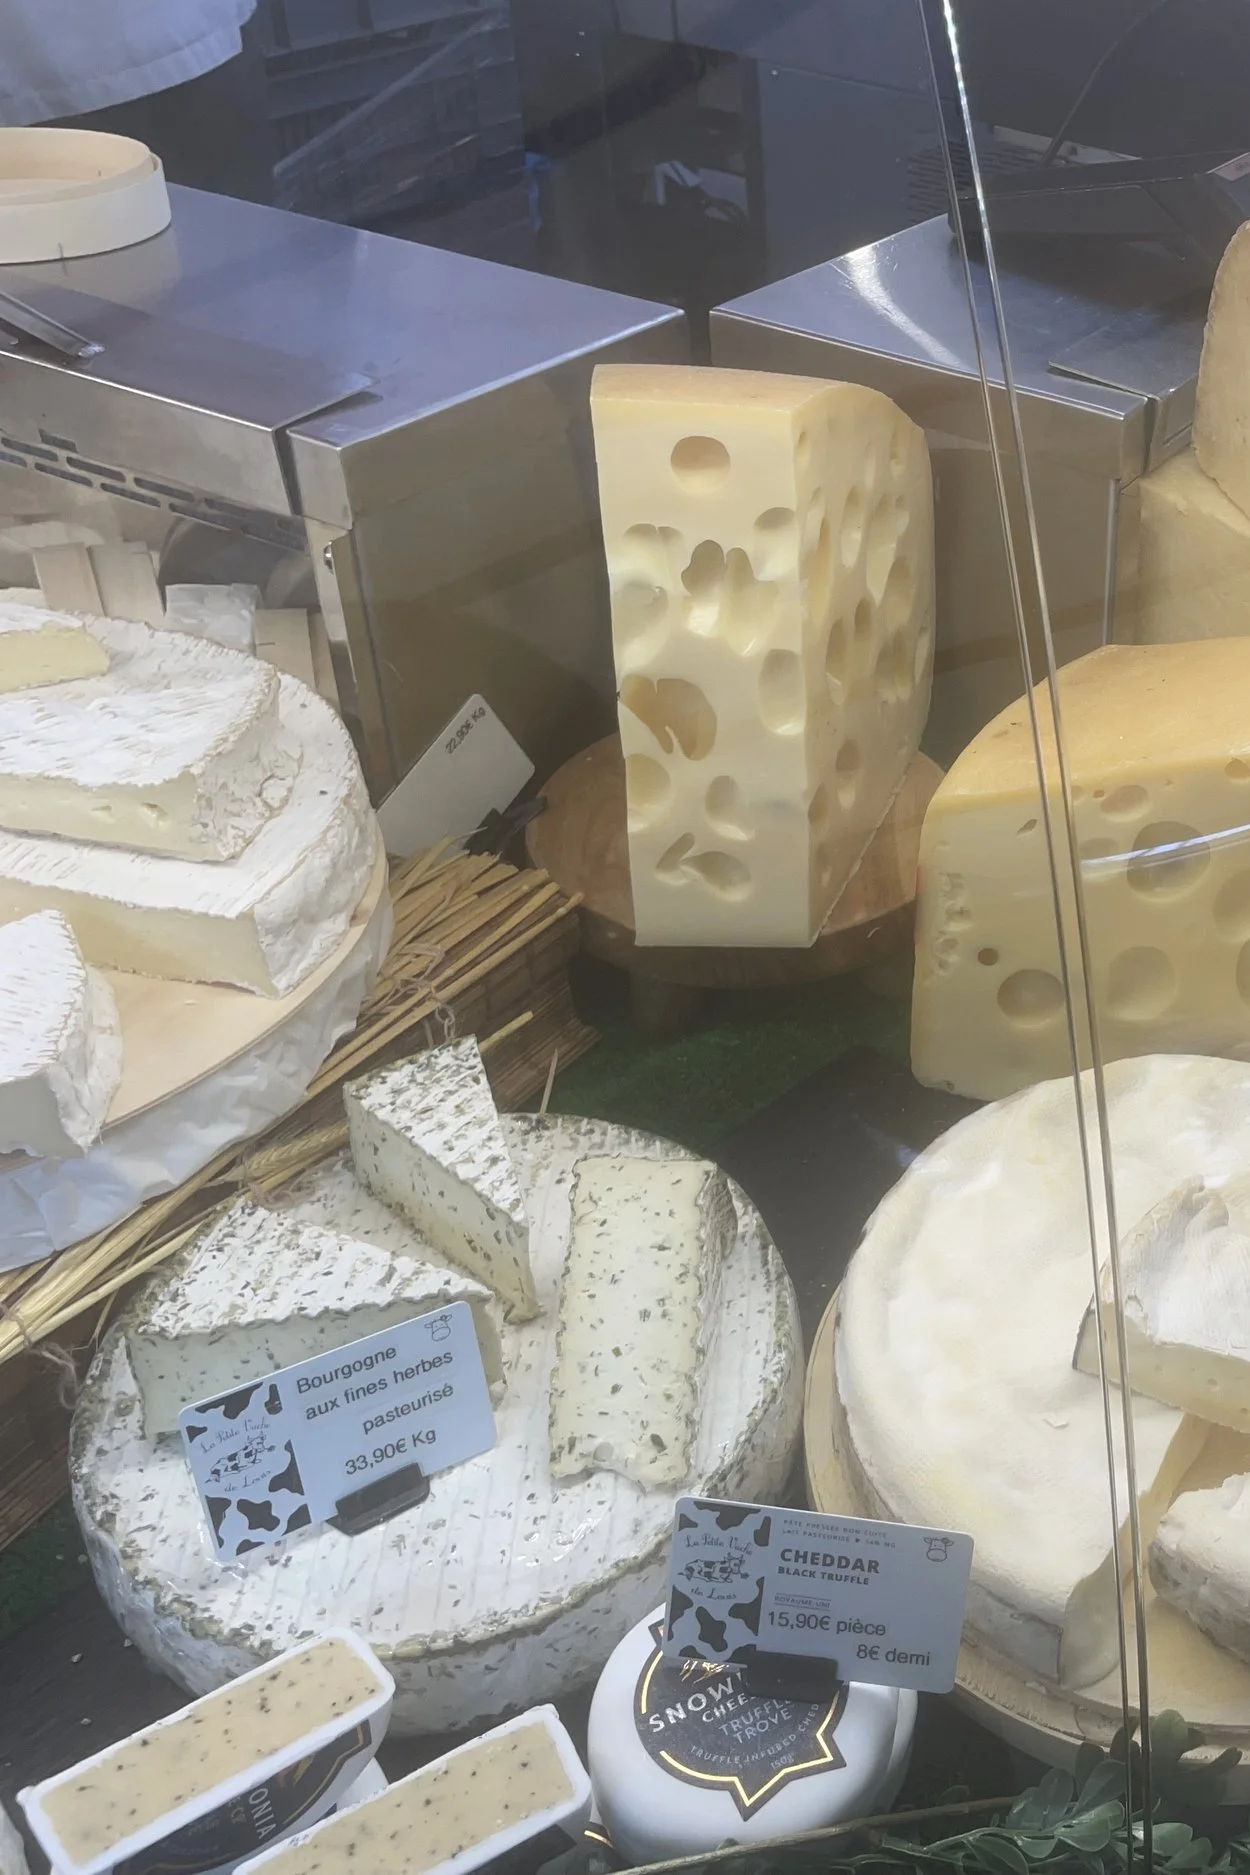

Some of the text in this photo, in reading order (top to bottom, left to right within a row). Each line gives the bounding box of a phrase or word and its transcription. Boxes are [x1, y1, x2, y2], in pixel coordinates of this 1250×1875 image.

[296, 1347, 397, 1394] Bourgogne
[305, 1352, 453, 1420] aux fines herbes
[362, 1383, 454, 1435] pasteurisé
[345, 1429, 437, 1475] 33,90€ Kg
[777, 1566, 870, 1586] BLACK TRUFFLE
[780, 1548, 881, 1574] CHEDDAR
[767, 1611, 887, 1637] 15,90€ pièce
[856, 1644, 931, 1666] 8€ demi
[649, 1672, 743, 1733] SNOW
[702, 1692, 756, 1723] CHEE
[733, 1709, 792, 1744] TROVE
[249, 1788, 277, 1840] ONIA
